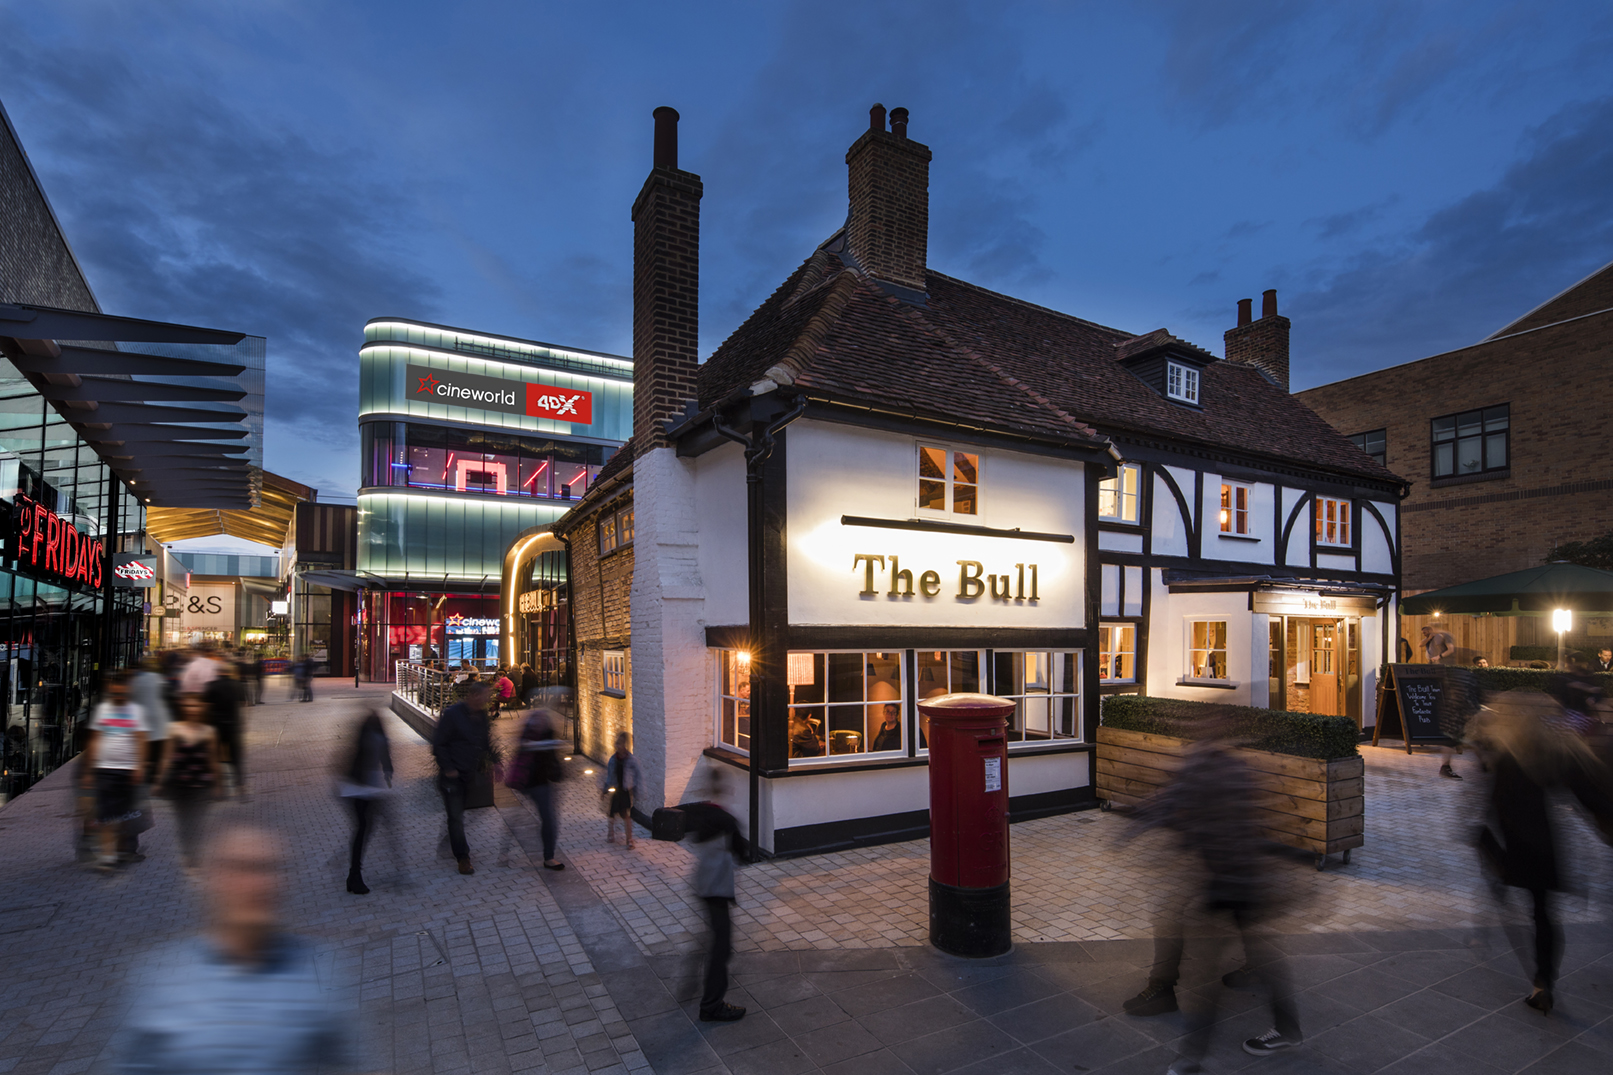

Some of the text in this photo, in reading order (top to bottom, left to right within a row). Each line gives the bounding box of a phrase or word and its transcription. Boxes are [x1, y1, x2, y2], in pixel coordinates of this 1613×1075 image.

[436, 382, 581, 415] cineworld 4DX
[31, 501, 103, 589] FRIDAYS
[852, 553, 1041, 601] The Bull
[1320, 600, 1337, 611] Bull
[1417, 684, 1430, 692] Bull
